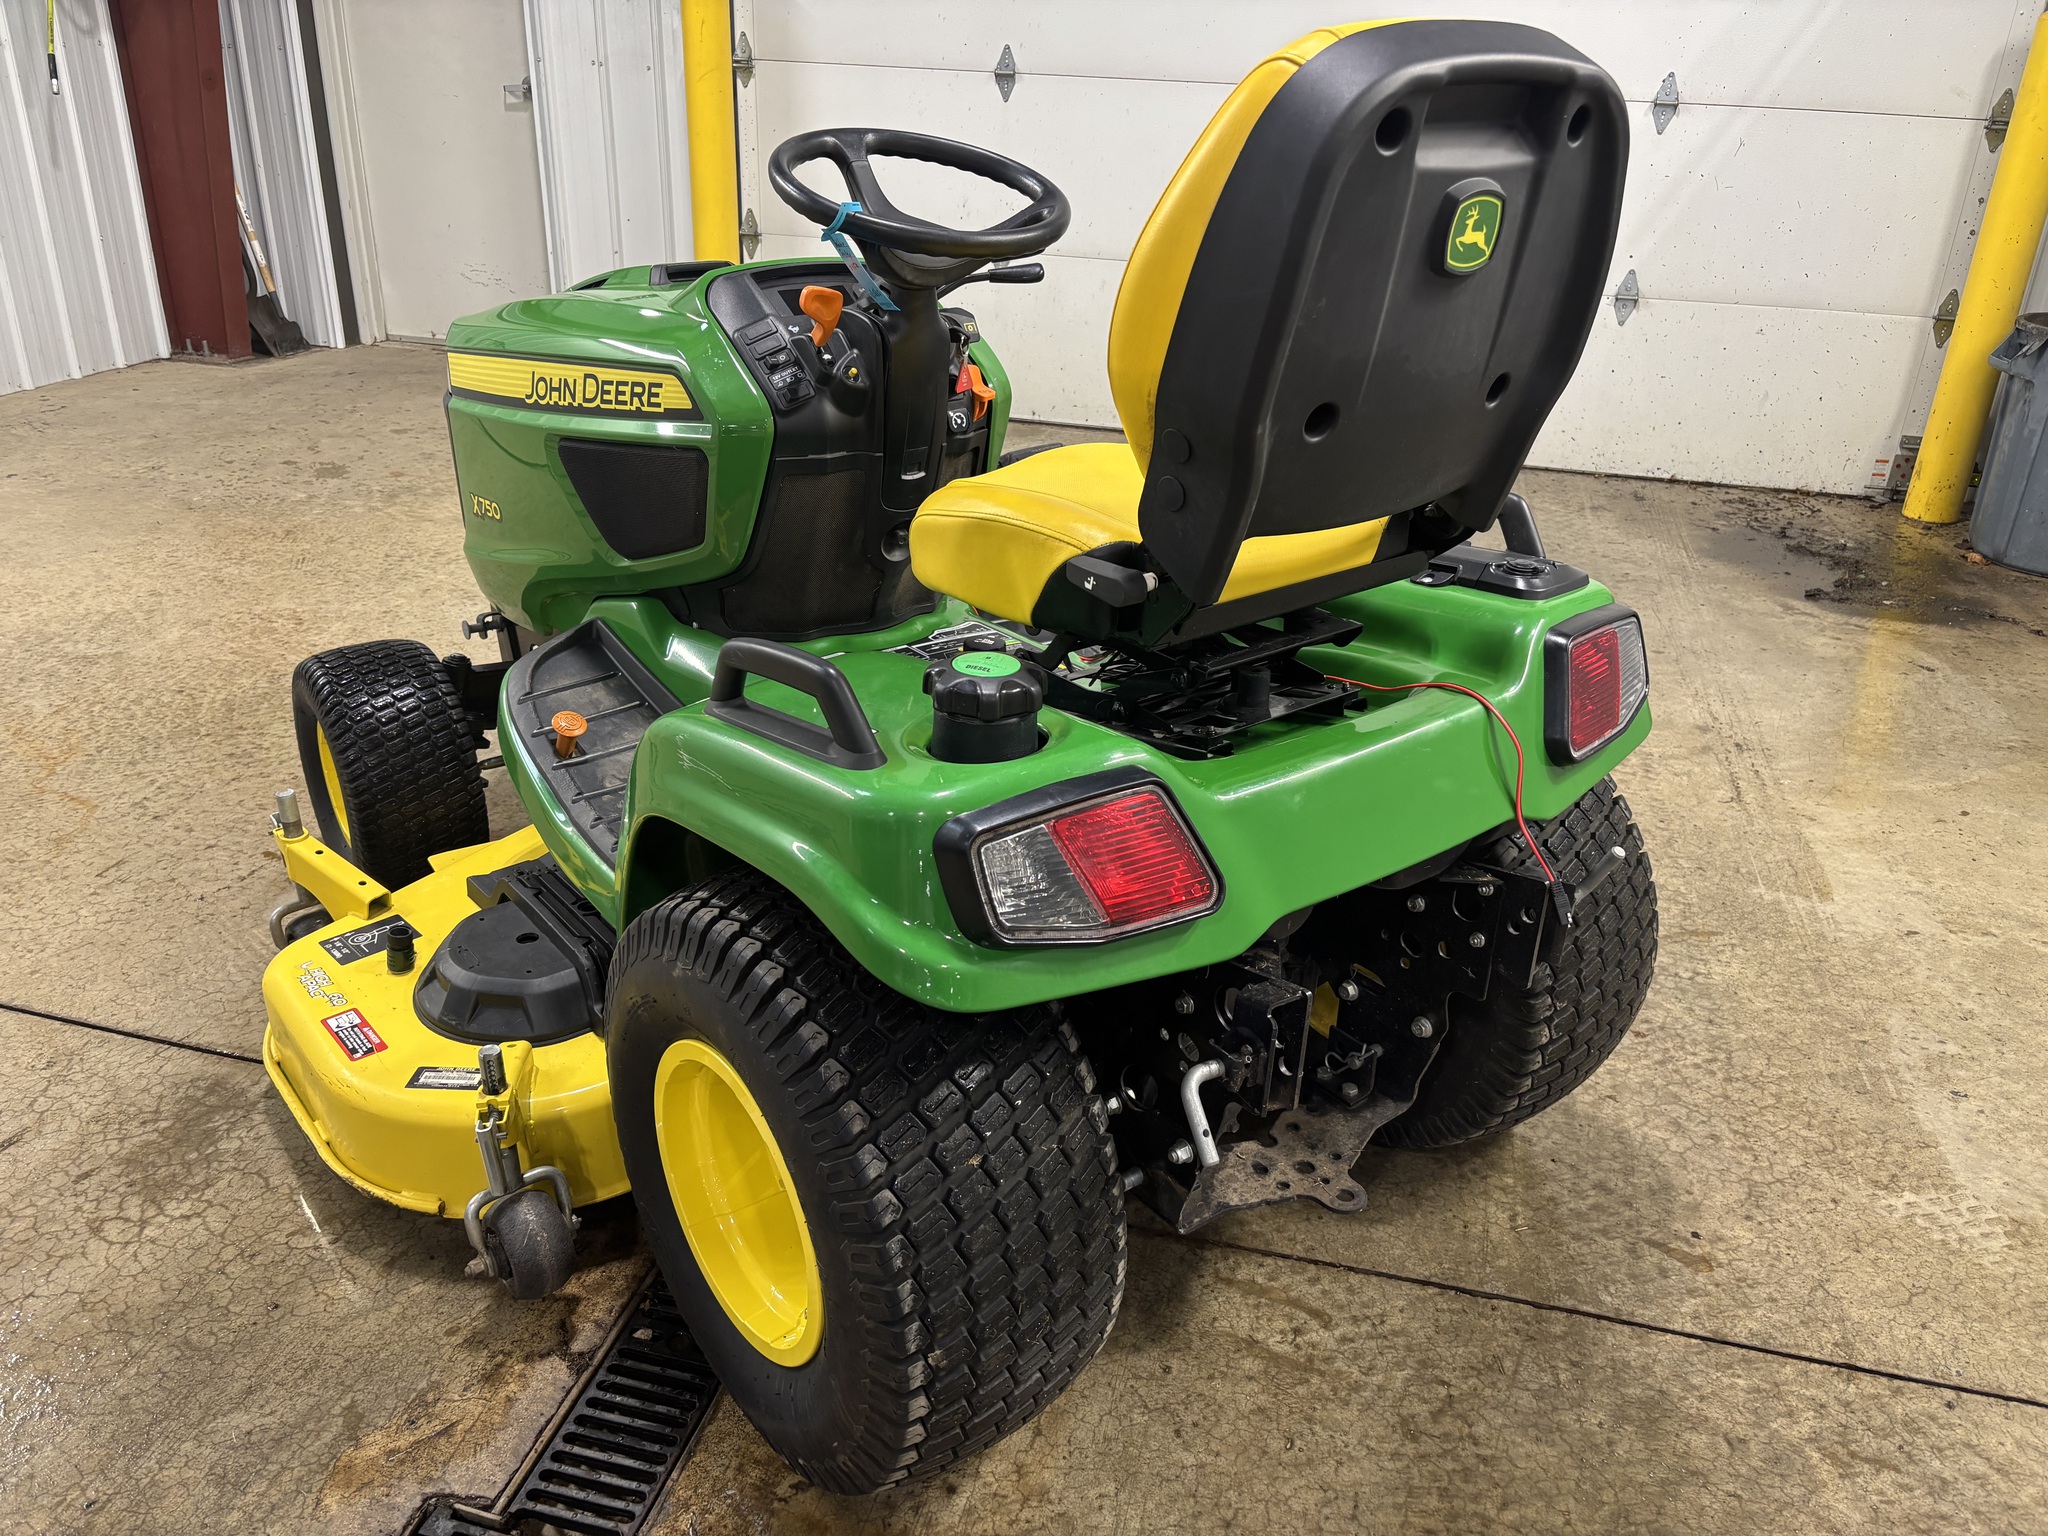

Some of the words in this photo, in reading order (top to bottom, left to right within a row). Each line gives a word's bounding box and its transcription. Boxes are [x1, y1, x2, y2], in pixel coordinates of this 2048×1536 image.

[780, 366, 799, 378] OUTLET
[525, 370, 577, 404] JOHN
[583, 373, 664, 410] DEERE
[470, 493, 502, 521] X750
[965, 664, 991, 673] DIESEL
